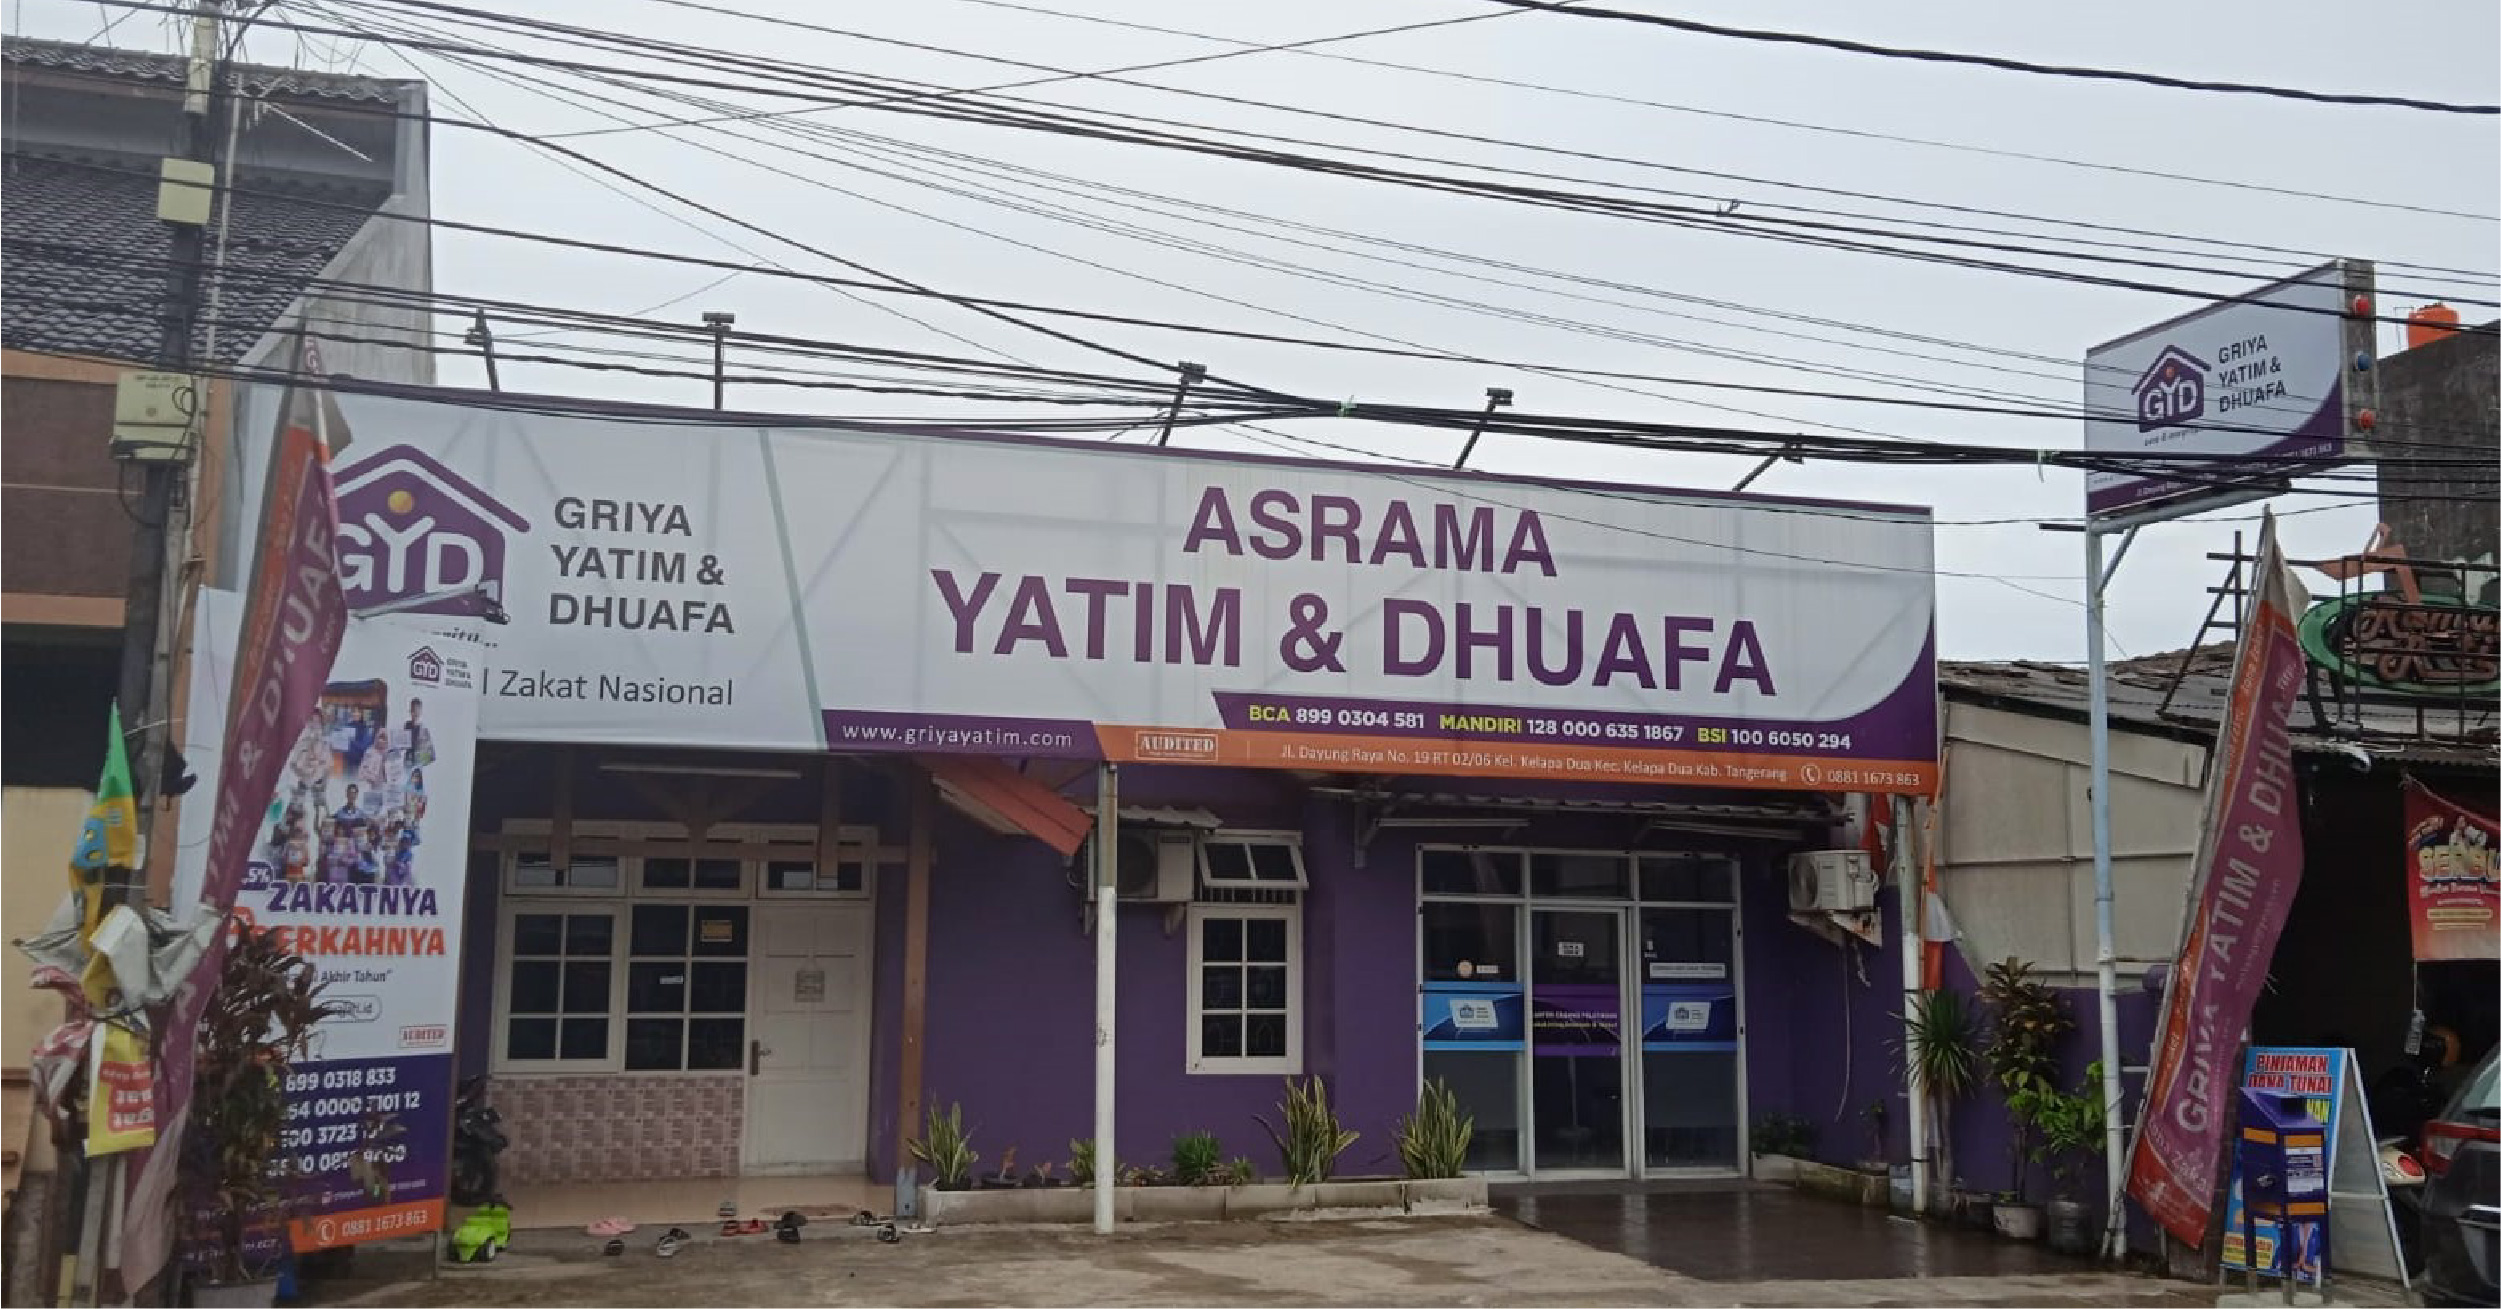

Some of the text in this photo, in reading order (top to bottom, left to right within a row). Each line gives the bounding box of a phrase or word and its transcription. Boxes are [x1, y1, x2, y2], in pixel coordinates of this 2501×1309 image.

[2218, 334, 2268, 364] GRIYA
[2219, 356, 2281, 388] YATIM &
[2144, 376, 2197, 420] GYD
[2219, 380, 2286, 412] DHUAFA
[553, 497, 692, 536] GRIYA
[1182, 485, 1558, 577] ASRAMA
[336, 513, 484, 593] GYD
[550, 543, 725, 586] YATIM &
[549, 593, 735, 633] DHUAFA
[930, 568, 1777, 697] YATIM & DHUAFA
[499, 669, 588, 700] Zakat
[599, 673, 733, 706] Nasional
[841, 722, 1073, 750] www.griyayatim.com
[1140, 735, 1215, 752] AUDITED
[1249, 705, 1851, 750] BCA 899 0304 581 MANDIRI 128 000 635 1867 BSI 100 6050 294
[1299, 745, 1348, 763] Dayung
[1351, 747, 1384, 765] Raya
[1387, 748, 1410, 763] No.
[1414, 750, 1430, 765] 19
[1433, 751, 1449, 766] RT
[1452, 752, 1491, 768] 02/06
[1493, 754, 1516, 768] Kel.
[1520, 755, 1563, 773] Kelapa
[1565, 757, 1592, 771] Dua
[1594, 758, 1621, 773] Kec.
[1623, 760, 1665, 777] Kelapa
[1667, 761, 1693, 775] Dua
[1696, 763, 1723, 777] Kab.
[1725, 764, 1788, 782] Tangerang
[1827, 770, 1920, 787] 0881 1673 863
[2238, 823, 2275, 855] &
[266, 882, 439, 916] ZAKATNYA
[257, 923, 446, 956] ERKAHNYA
[323, 1068, 362, 1089] 0318
[365, 1066, 396, 1086] 833
[404, 1090, 420, 1109] 12
